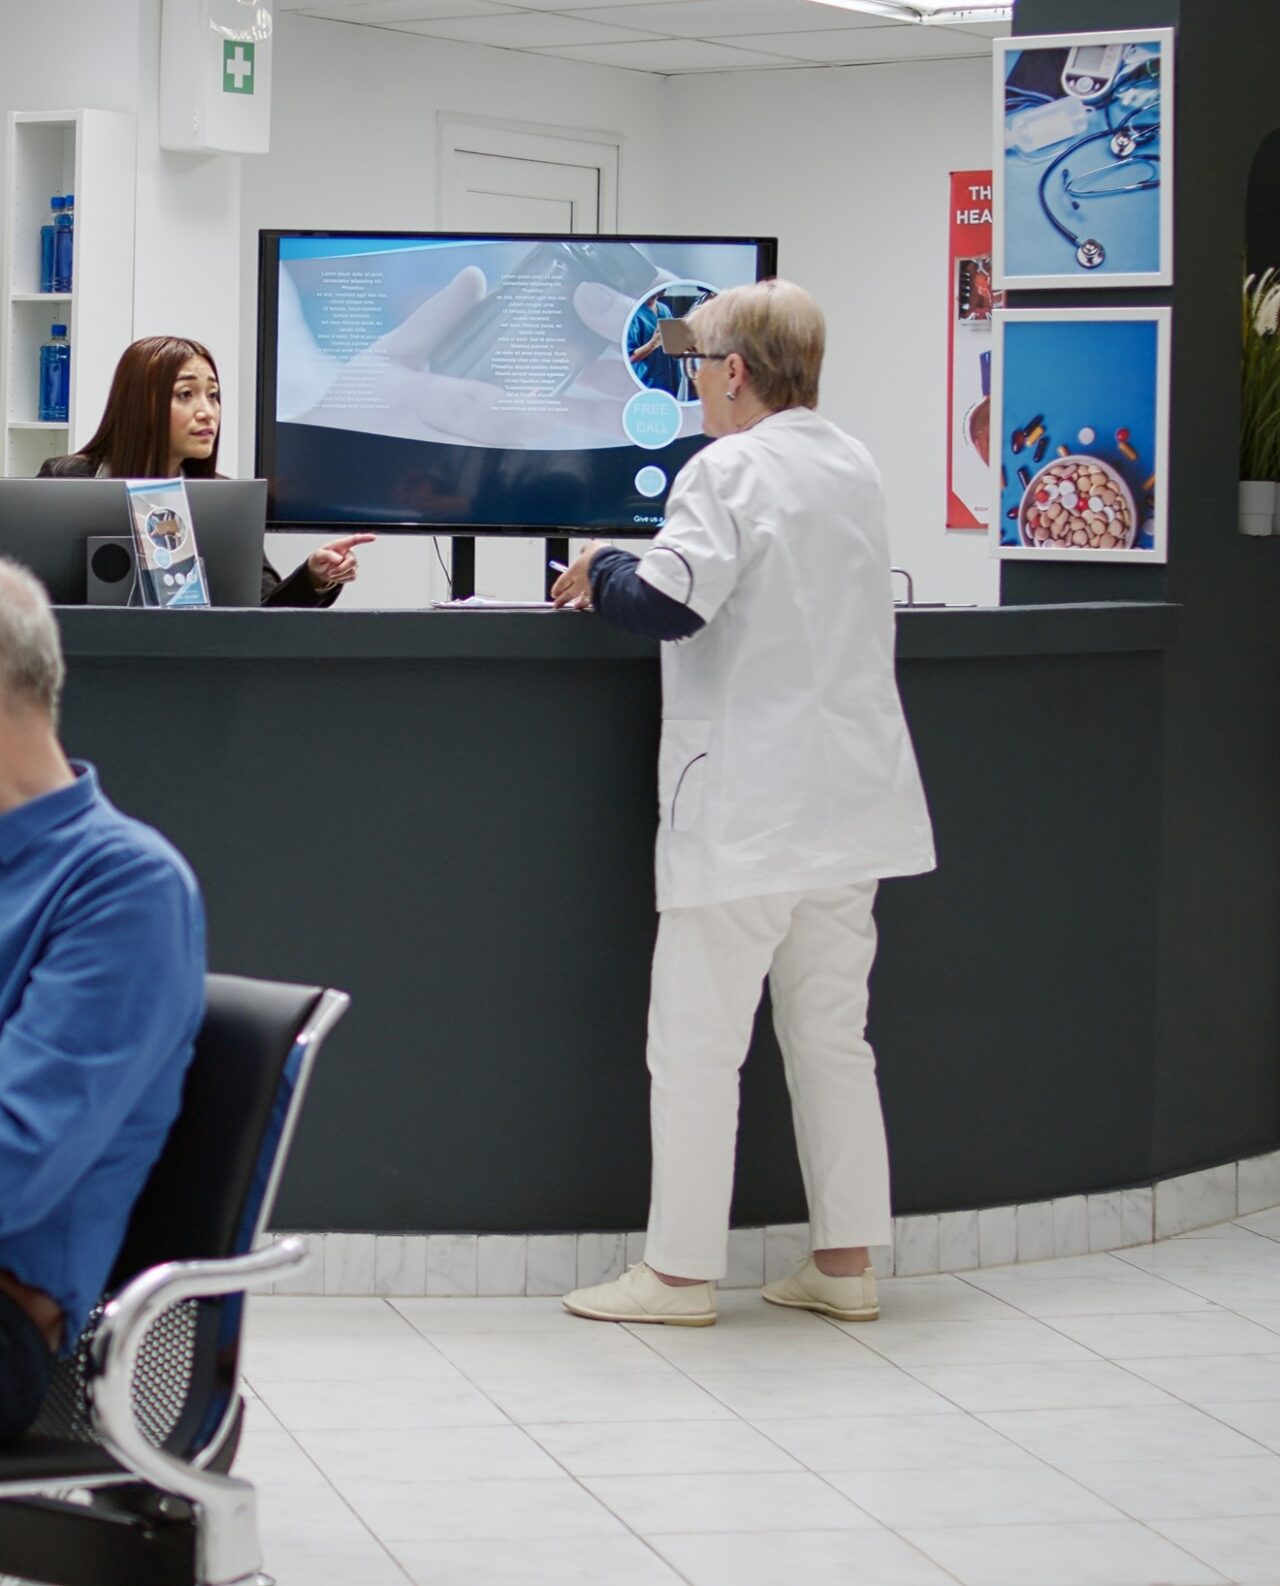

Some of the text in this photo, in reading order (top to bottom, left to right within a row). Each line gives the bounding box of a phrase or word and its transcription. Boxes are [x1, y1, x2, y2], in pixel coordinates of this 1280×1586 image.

[968, 185, 992, 200] TH
[956, 209, 992, 224] HEA
[633, 403, 669, 415] FREE
[636, 421, 669, 433] CALL
[633, 515, 649, 523] Give
